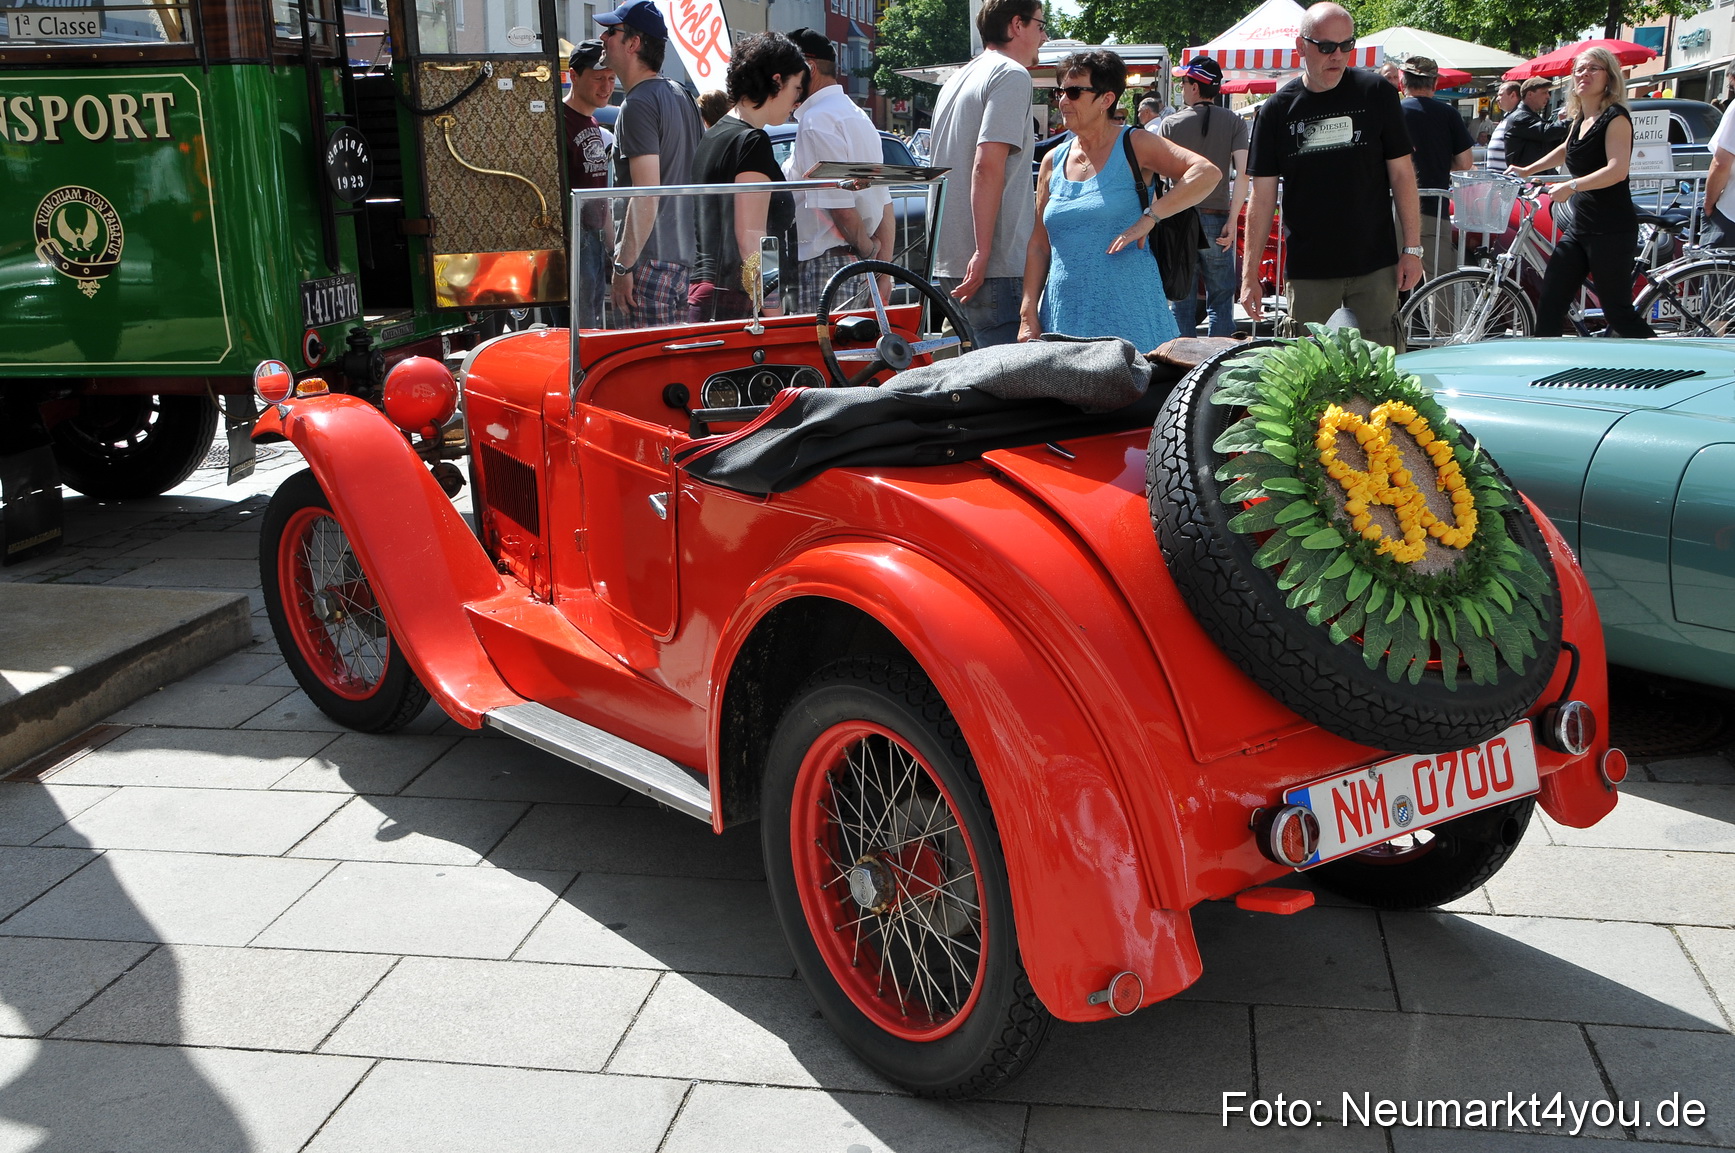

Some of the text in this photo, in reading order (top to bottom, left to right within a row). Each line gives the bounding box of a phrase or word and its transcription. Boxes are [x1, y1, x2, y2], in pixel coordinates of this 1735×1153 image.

[38, 16, 97, 36] Classe
[1320, 121, 1349, 131] DIESEL
[1631, 115, 1659, 126] TWEIT
[337, 175, 364, 190] 1923
[37, 188, 82, 227] NUNQUAM
[84, 192, 108, 212] NON
[1332, 773, 1390, 844] NM
[1412, 737, 1515, 816] 0700
